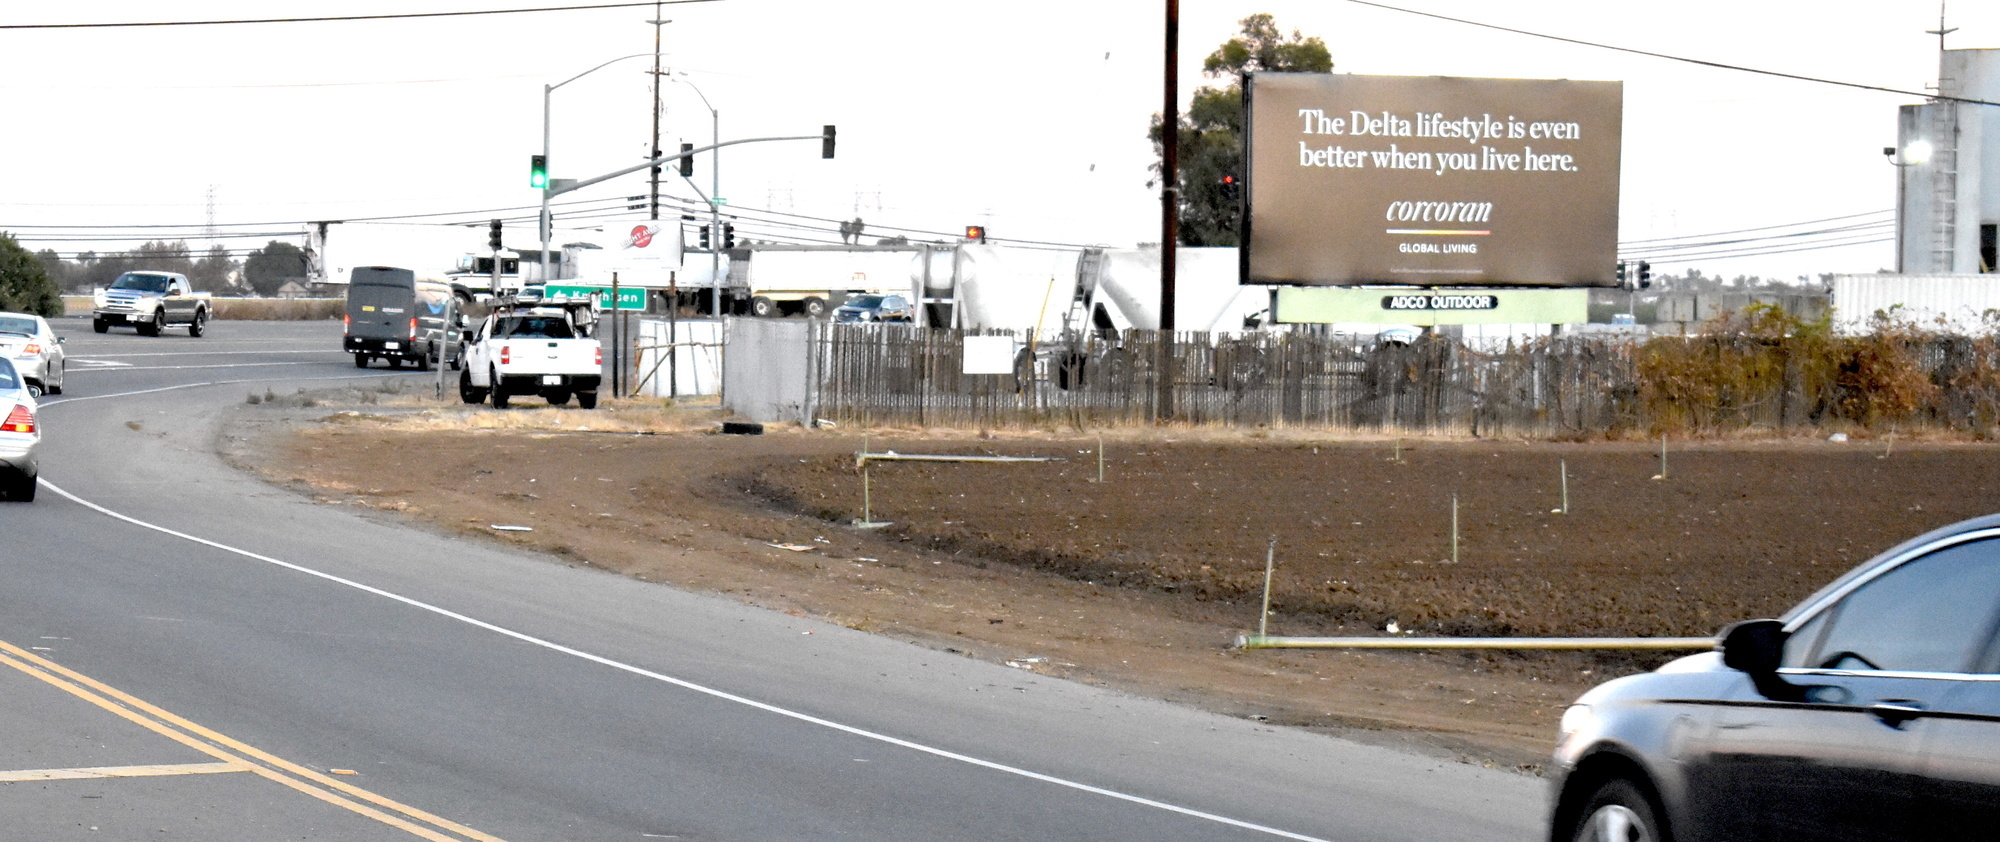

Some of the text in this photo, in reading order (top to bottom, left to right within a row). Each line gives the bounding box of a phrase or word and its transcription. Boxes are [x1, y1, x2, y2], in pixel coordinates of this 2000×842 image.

[1298, 109, 1580, 144] The Delta lifestyle is even
[1299, 141, 1578, 175] better when you live here.
[1386, 199, 1493, 223] corcoran
[1399, 243, 1477, 254] GLOBAL LIVING
[1391, 296, 1490, 309] ADCO OUTDOOR
